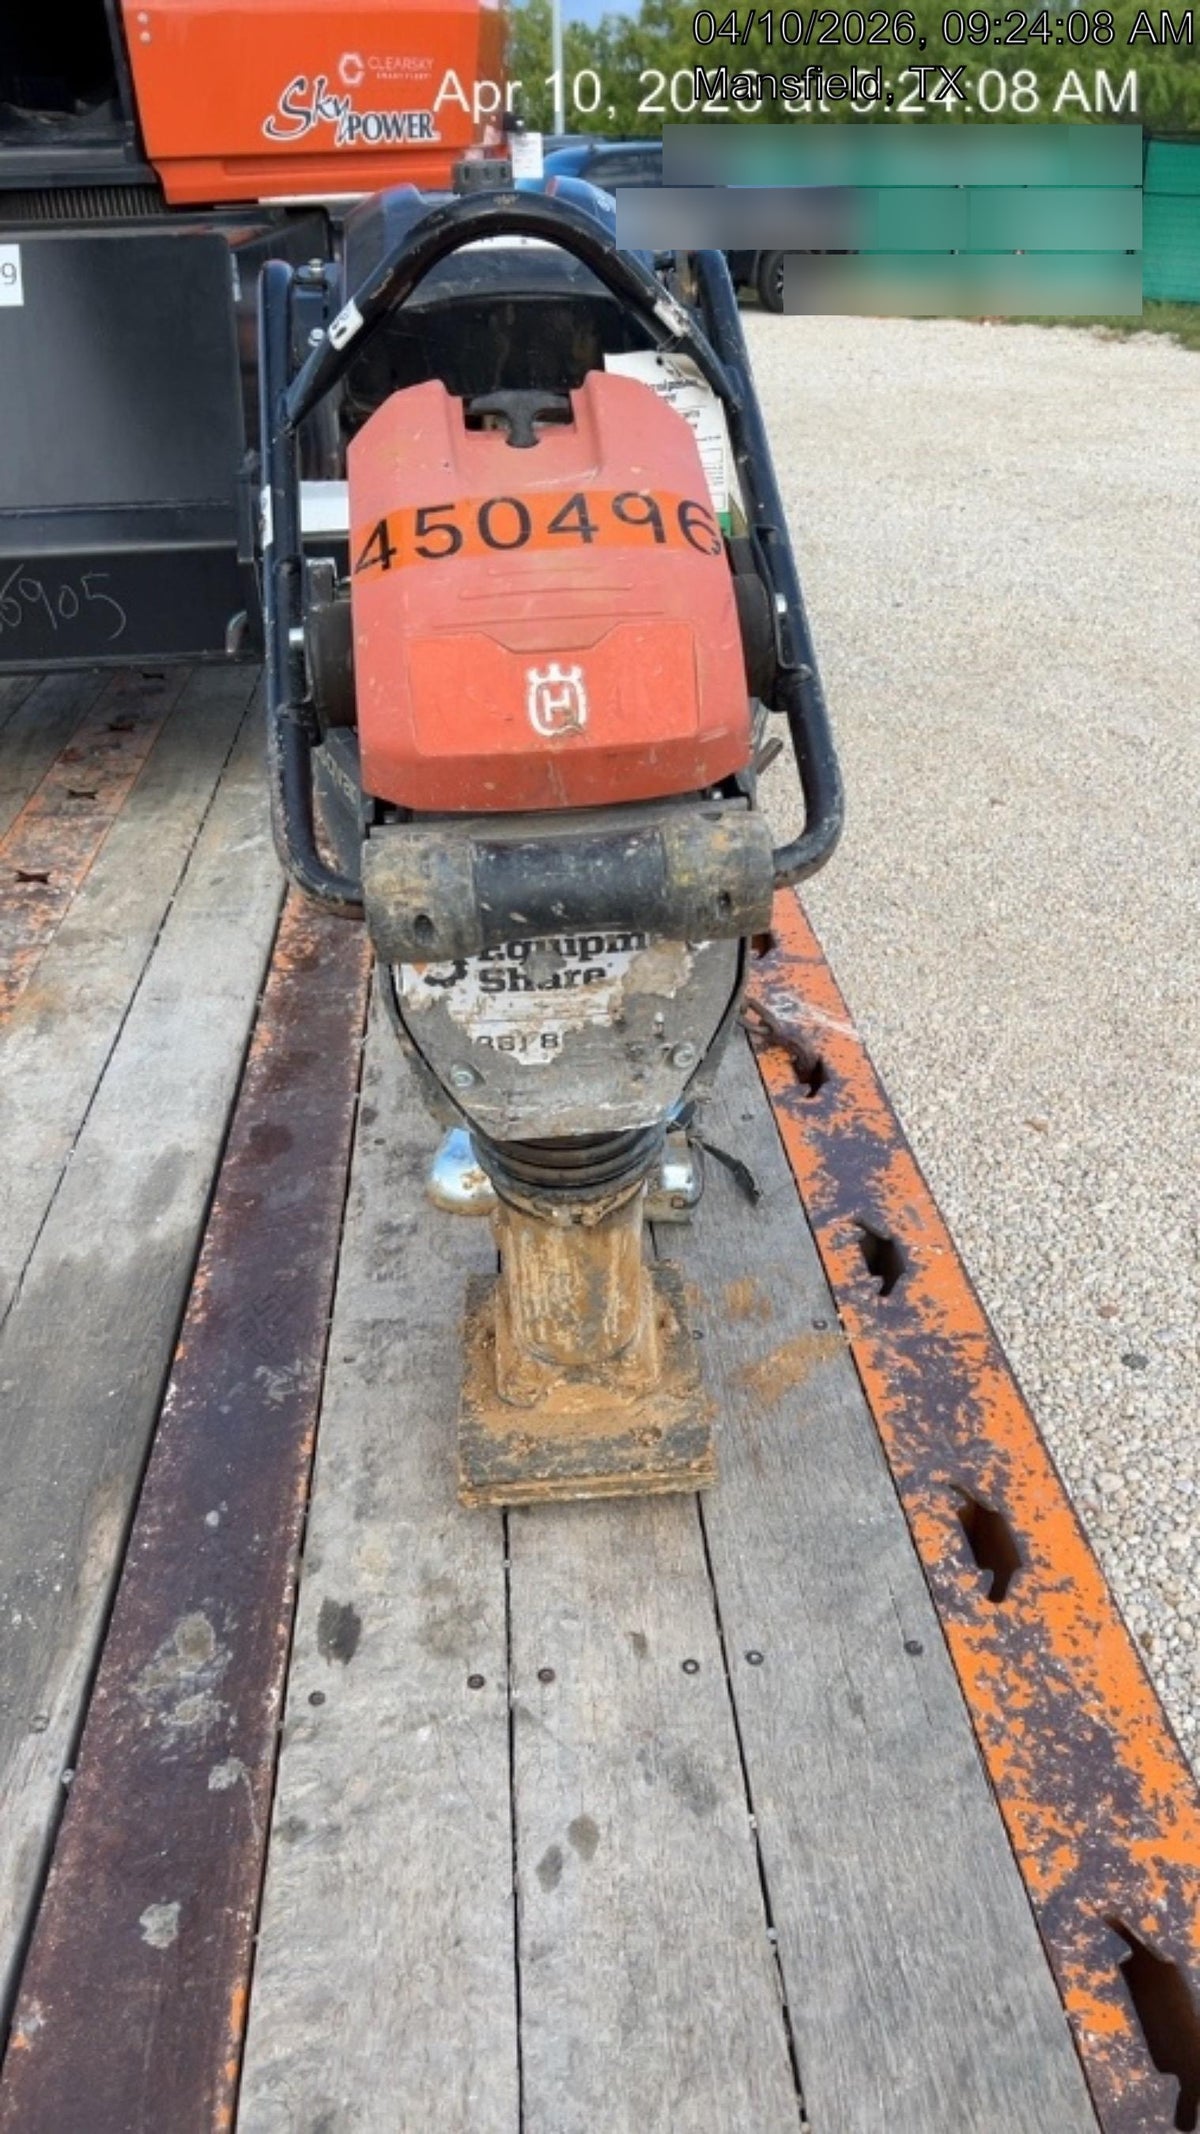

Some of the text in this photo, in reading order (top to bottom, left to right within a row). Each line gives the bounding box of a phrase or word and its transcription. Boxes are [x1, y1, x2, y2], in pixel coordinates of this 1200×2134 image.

[367, 56, 434, 70] CLEARSKY
[263, 75, 437, 147] Sky POWER
[354, 491, 720, 573] 450496
